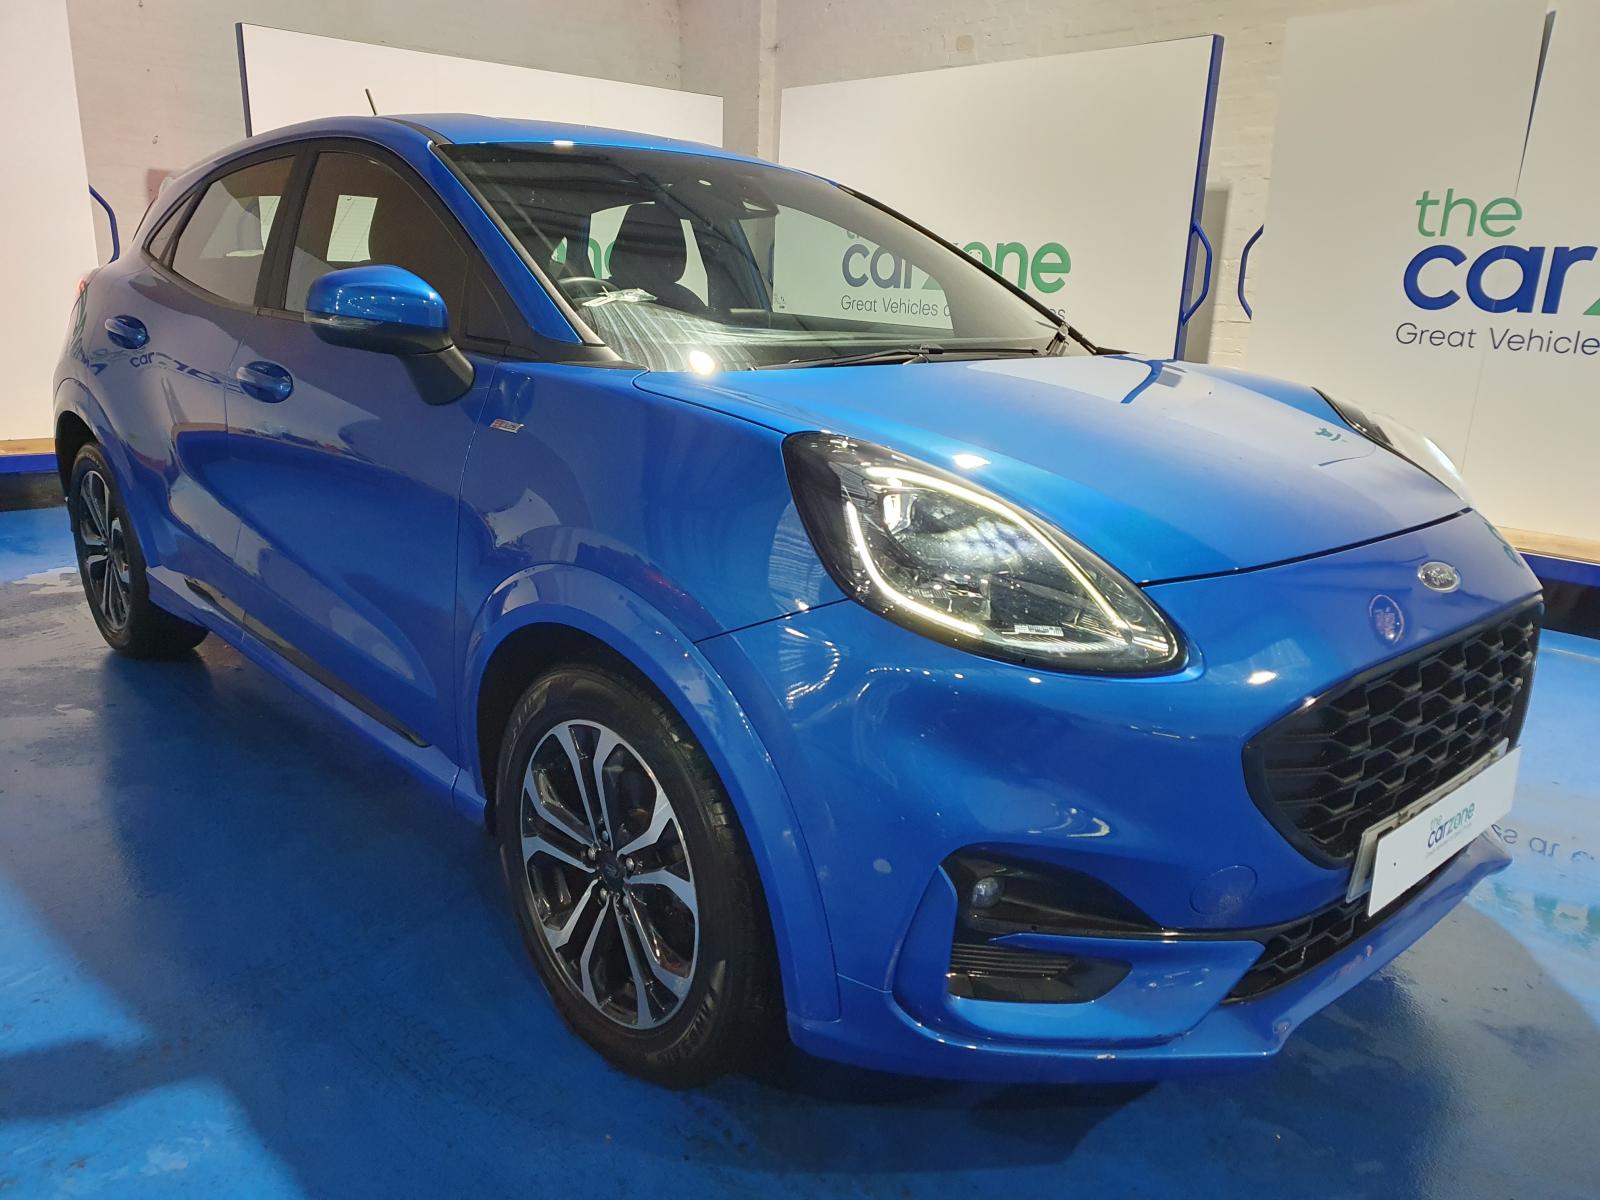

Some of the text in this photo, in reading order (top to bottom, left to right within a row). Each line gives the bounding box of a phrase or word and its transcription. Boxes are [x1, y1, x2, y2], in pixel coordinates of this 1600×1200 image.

[1415, 188, 1523, 238] the
[840, 294, 878, 313] Great
[882, 297, 939, 317] Vehicles
[1395, 322, 1477, 349] Great
[1427, 802, 1476, 849] carzone
